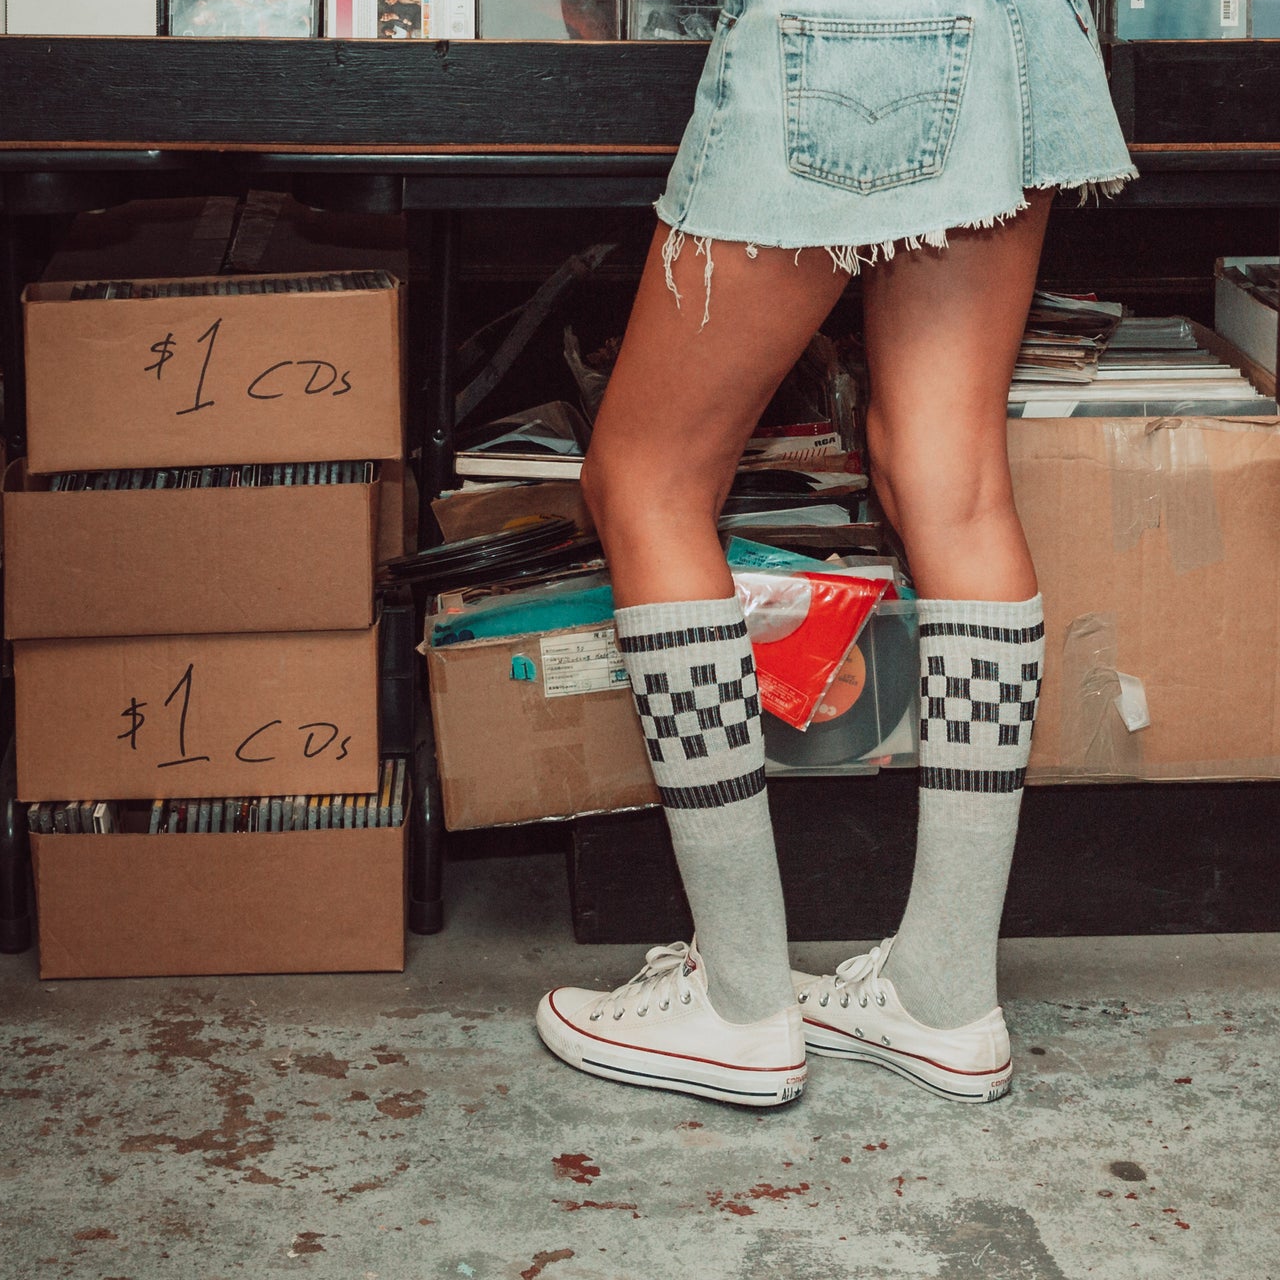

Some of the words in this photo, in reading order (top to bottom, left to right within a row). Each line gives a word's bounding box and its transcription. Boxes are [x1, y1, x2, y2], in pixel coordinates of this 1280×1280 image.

[144, 318, 224, 417] $1
[246, 359, 354, 402] CDs
[814, 436, 838, 448] RCA
[116, 663, 212, 769] $1
[234, 720, 353, 764] CDs
